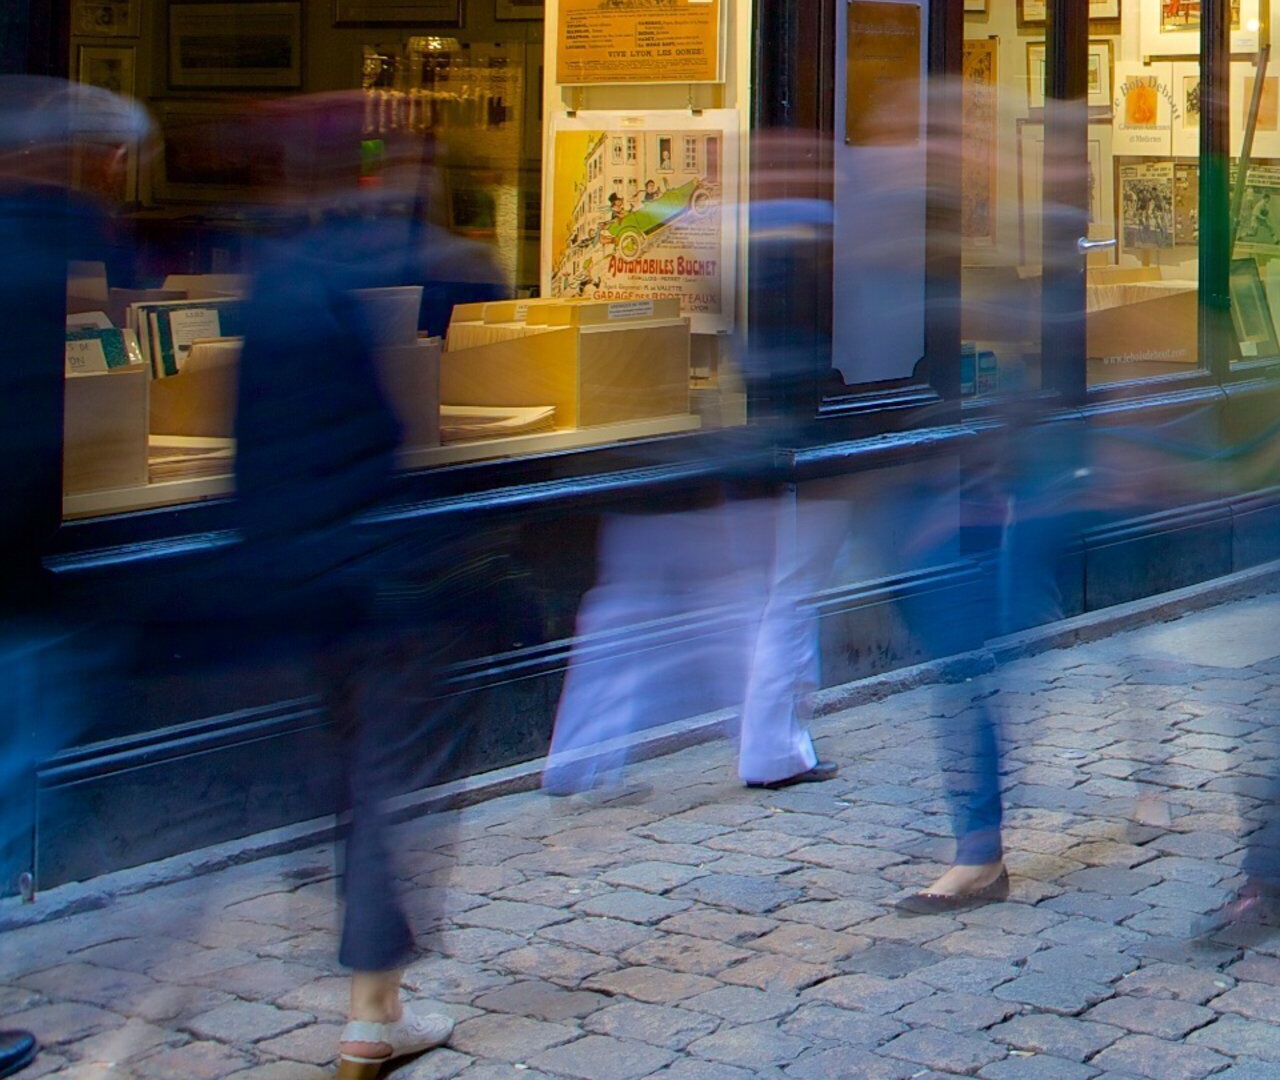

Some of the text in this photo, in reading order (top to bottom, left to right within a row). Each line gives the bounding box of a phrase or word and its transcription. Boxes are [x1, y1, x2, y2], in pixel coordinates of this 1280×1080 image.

[608, 255, 716, 277] AUTOMOBILES BUCHET
[593, 291, 634, 301] GARAGE
